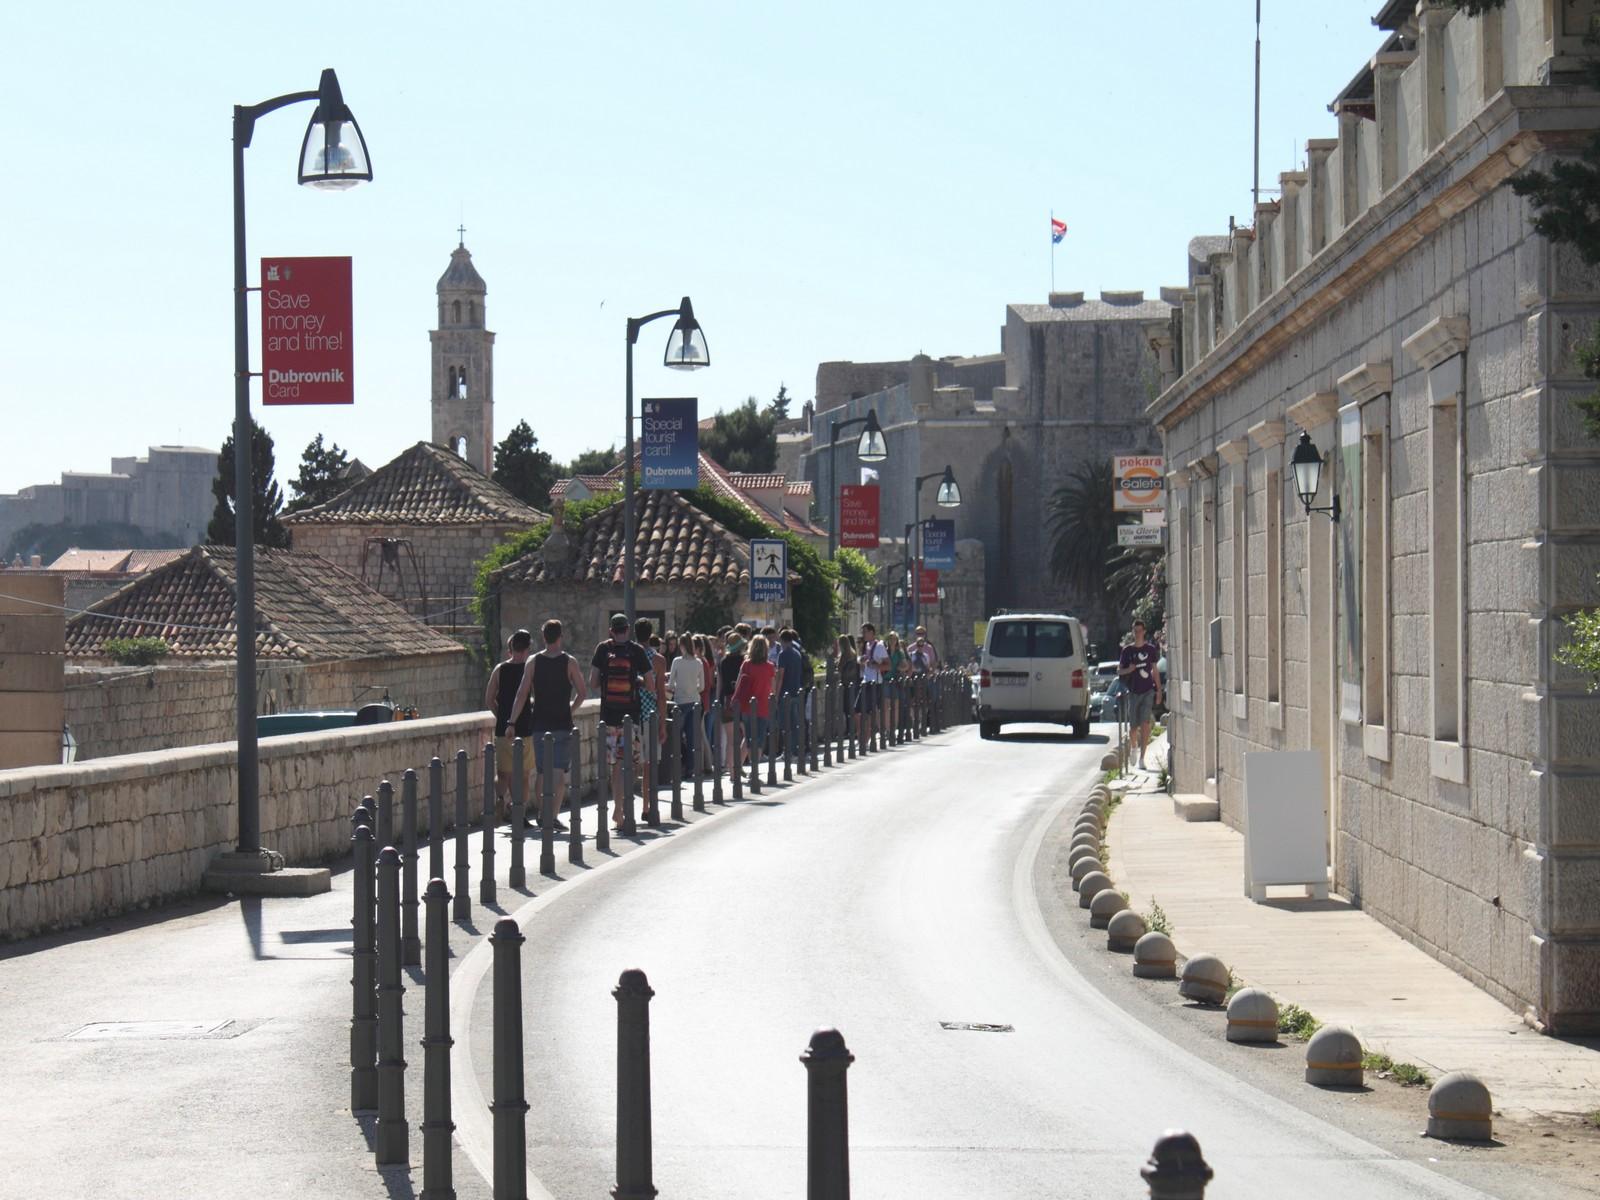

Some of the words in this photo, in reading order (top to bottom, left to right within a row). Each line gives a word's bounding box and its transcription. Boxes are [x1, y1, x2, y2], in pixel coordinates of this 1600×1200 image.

[268, 289, 310, 309] Save
[268, 314, 325, 334] money
[268, 332, 300, 351] and
[304, 331, 343, 350] time!
[269, 369, 344, 383] Dubrovnik
[268, 384, 300, 398] Card
[645, 417, 682, 432] Special
[645, 431, 676, 443] tourist
[1120, 456, 1162, 469] pekara
[645, 467, 692, 475] Dubrovnik
[1121, 479, 1161, 488] Galeta
[754, 580, 782, 590] Školska
